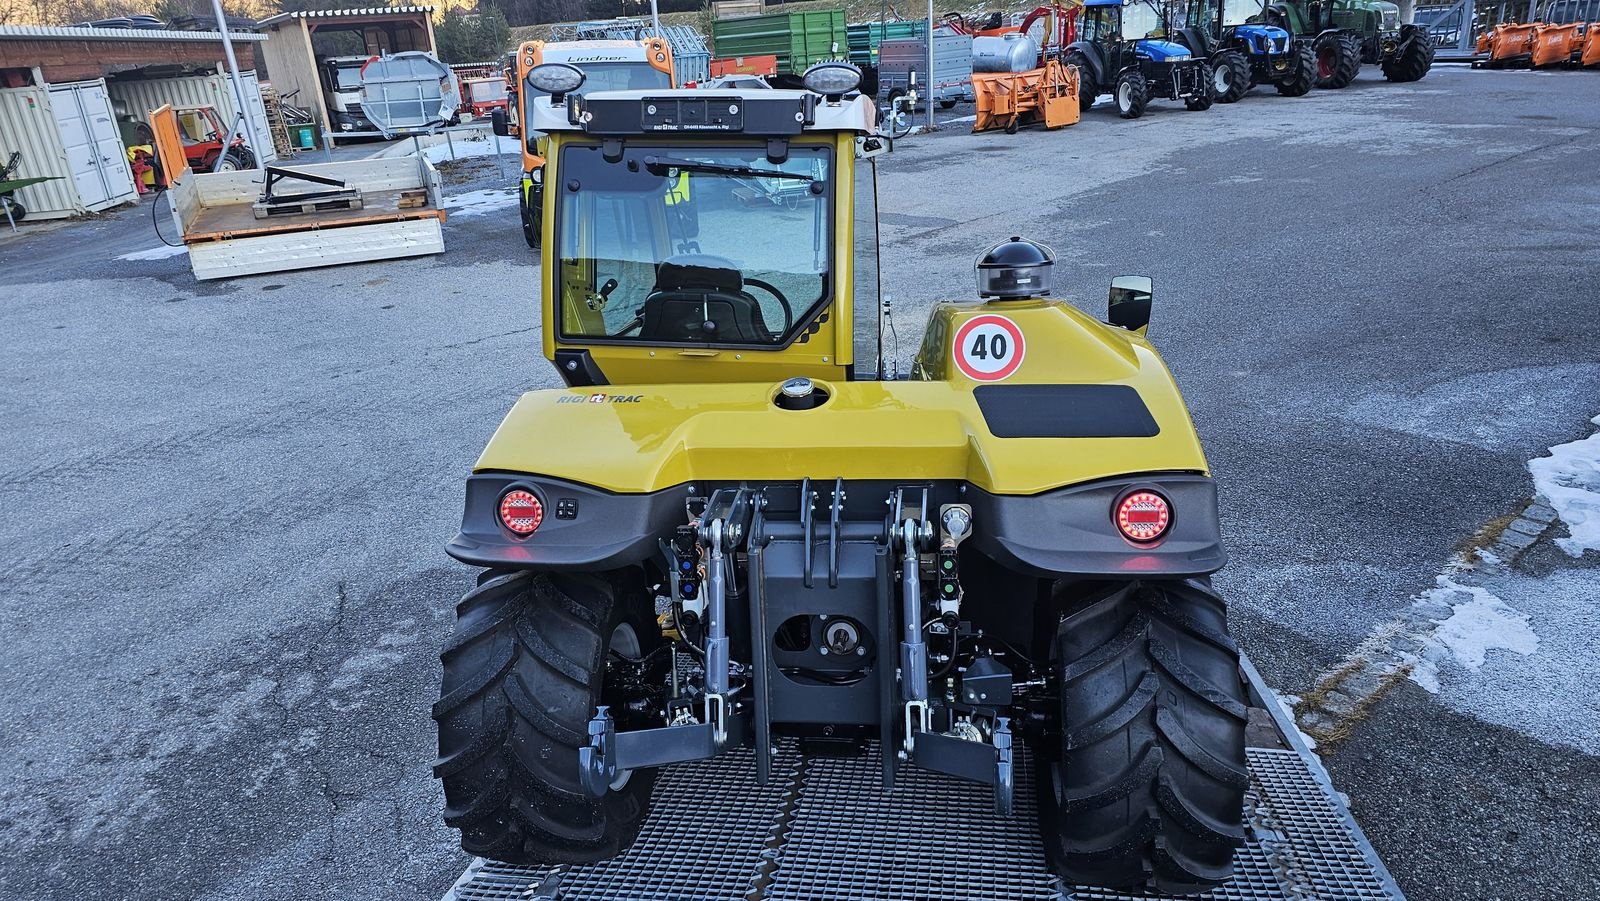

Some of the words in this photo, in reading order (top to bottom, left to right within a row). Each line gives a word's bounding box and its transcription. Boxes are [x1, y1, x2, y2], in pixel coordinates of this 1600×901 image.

[568, 55, 628, 63] Lindner
[971, 333, 1007, 360] 40
[556, 395, 587, 404] RIGI
[608, 394, 644, 403] TRAC
